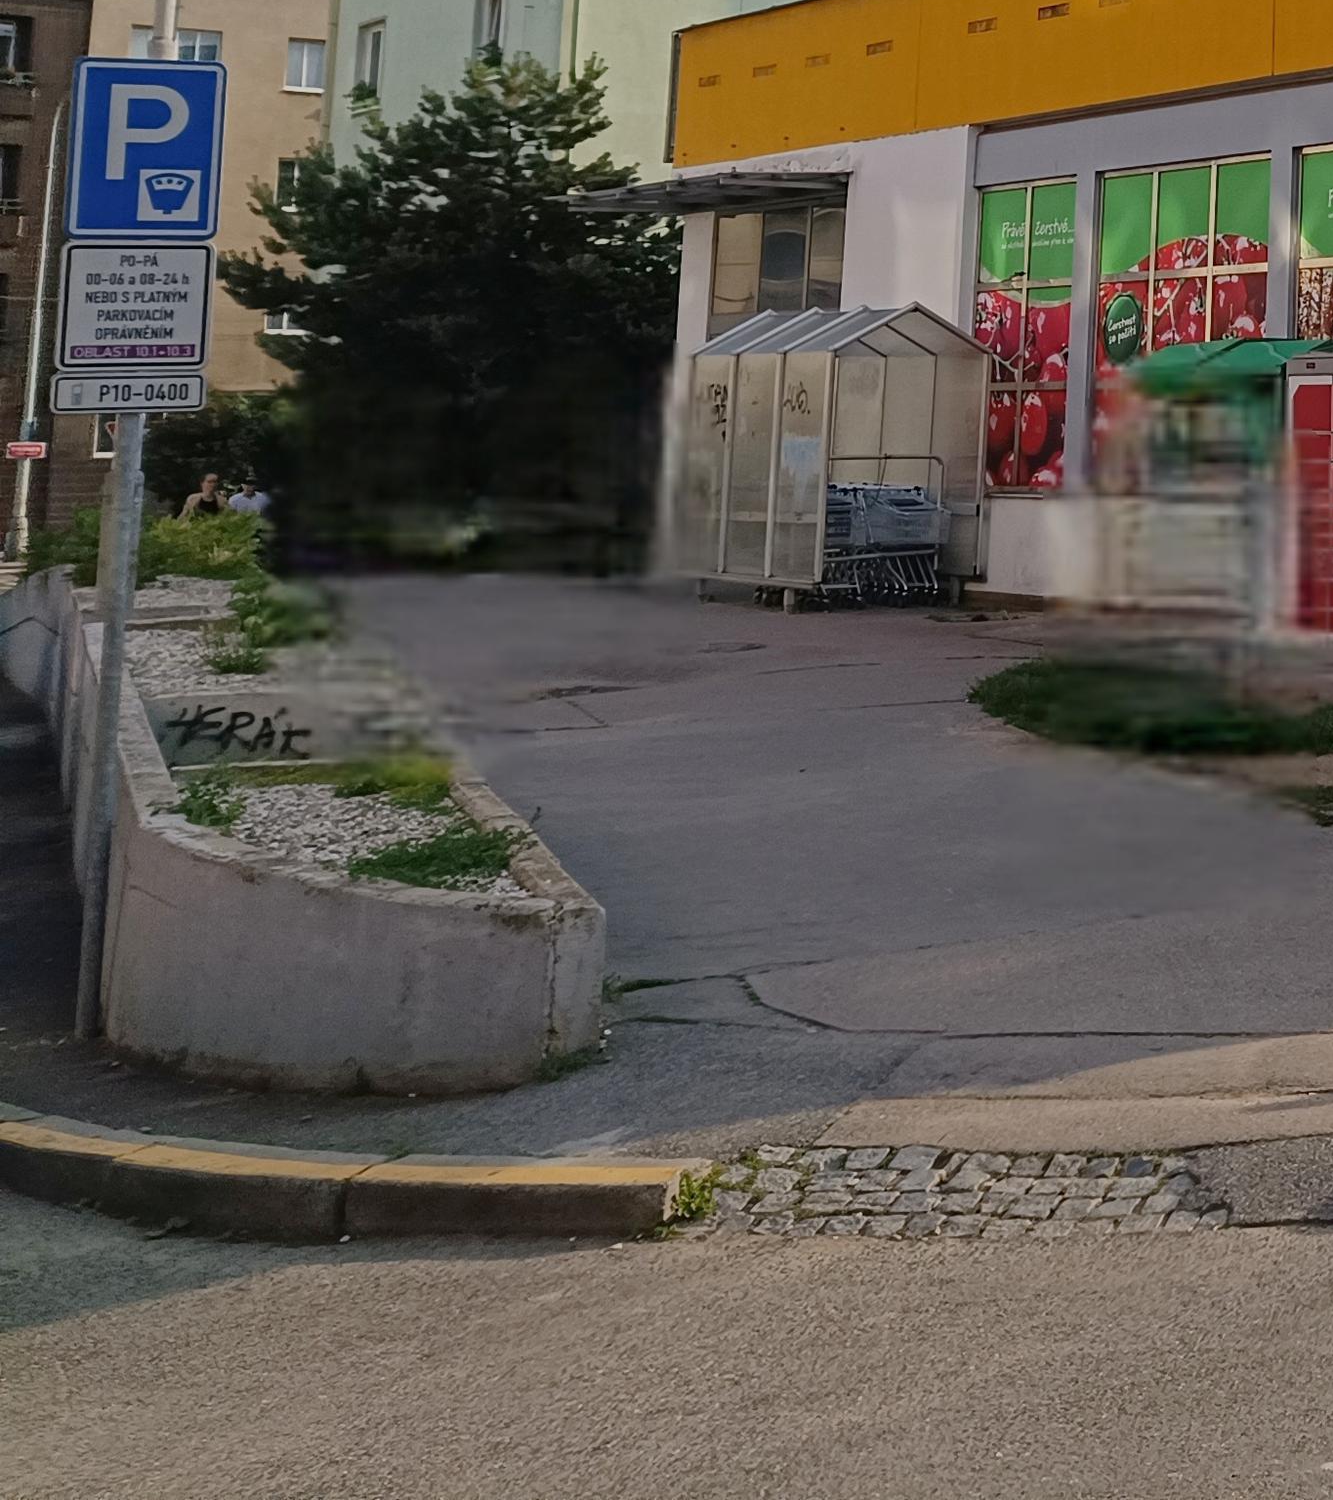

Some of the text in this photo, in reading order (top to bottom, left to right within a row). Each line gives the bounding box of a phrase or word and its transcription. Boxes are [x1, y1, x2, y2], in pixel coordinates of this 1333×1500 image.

[105, 84, 190, 180] P
[85, 291, 118, 303] NEBO
[121, 291, 130, 303] S
[97, 307, 174, 321] PARKOVACÍM
[73, 347, 131, 358] OBLAST
[99, 384, 189, 402] P10-0400
